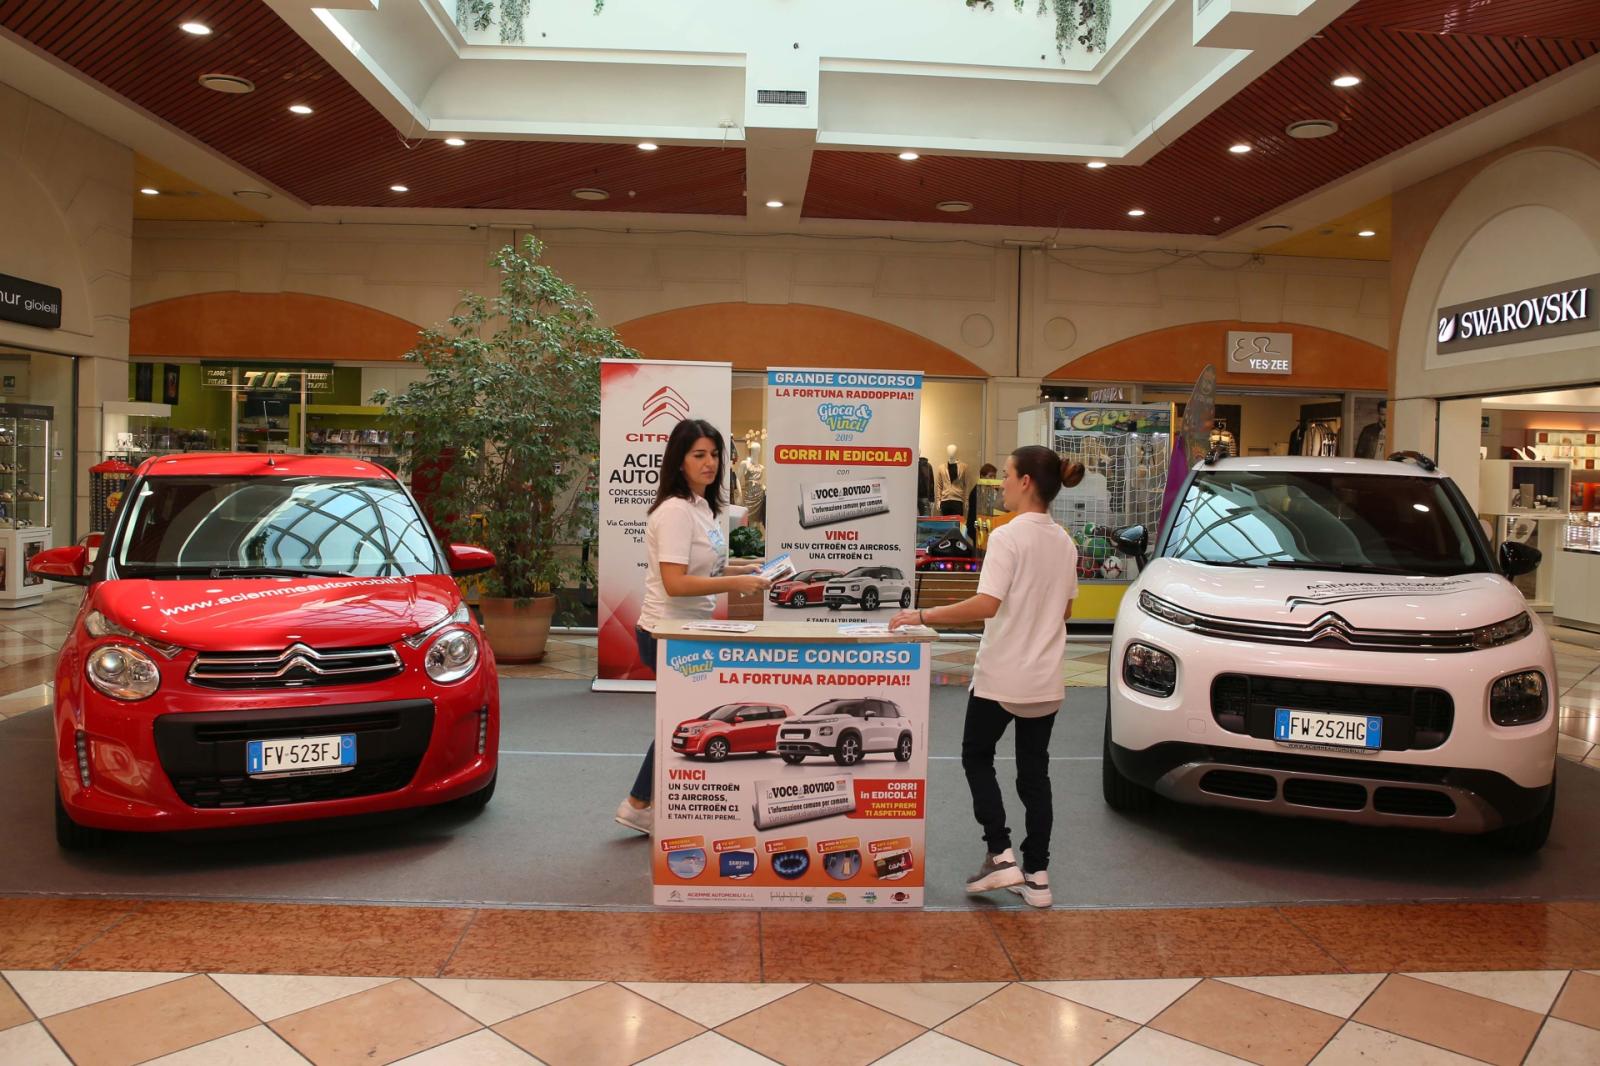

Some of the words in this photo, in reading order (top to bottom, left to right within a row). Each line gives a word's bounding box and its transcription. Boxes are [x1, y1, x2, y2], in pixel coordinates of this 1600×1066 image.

[1461, 288, 1587, 339] SWAROVSKI
[775, 372, 834, 384] GRANDE
[838, 374, 915, 387] CONCORSO
[775, 388, 790, 397] LA
[793, 388, 844, 399] FORTUNA
[846, 389, 914, 400] RADDOPPIA!!
[818, 404, 854, 420] Gioca
[855, 404, 872, 419] &
[827, 415, 868, 432] Vinci!
[625, 433, 669, 442] CITR
[835, 433, 853, 442] 2019
[623, 453, 663, 468] ACIE
[825, 450, 840, 461] IN
[843, 451, 908, 462] EDICOLA!
[609, 469, 660, 484] AUTO
[608, 488, 657, 496] CONCESSIO
[843, 484, 871, 497] ROVIGO
[631, 497, 657, 505] ROVIG
[825, 530, 859, 541] VINCI
[811, 542, 847, 550] CITROËN
[859, 544, 901, 552] AIRCROSS,
[809, 552, 826, 560] UNA
[827, 552, 862, 560] CITROËN
[160, 576, 414, 617] www.aciemmeautomobili.it
[671, 652, 700, 671] Gioca
[702, 649, 715, 660] &
[718, 648, 799, 662] GRANDE
[805, 649, 911, 664] CONCORSO
[719, 672, 739, 684] LA
[742, 673, 813, 685] FORTUNA
[816, 674, 911, 686] RADDOPPIA!!
[1290, 717, 1311, 736] FW
[1315, 719, 1366, 741] 252HG
[264, 746, 284, 765] FV
[290, 742, 340, 764] 523FJ
[668, 769, 706, 780] VINCI
[668, 783, 681, 791] UN
[683, 783, 700, 791] SUV
[701, 782, 740, 791] CITROËN
[803, 781, 835, 795] ROVIGO
[887, 782, 918, 790] CORRI
[668, 793, 680, 801] C3
[681, 793, 728, 802] AIRCROSS,
[860, 791, 870, 799] in
[871, 791, 917, 799] EDICOLA!
[668, 803, 687, 811] UNA
[688, 803, 727, 812] CITROËN
[715, 842, 722, 851] 4
[768, 843, 773, 852] 1
[819, 843, 825, 852] 1
[871, 844, 877, 852] 5
[888, 856, 906, 870] card
